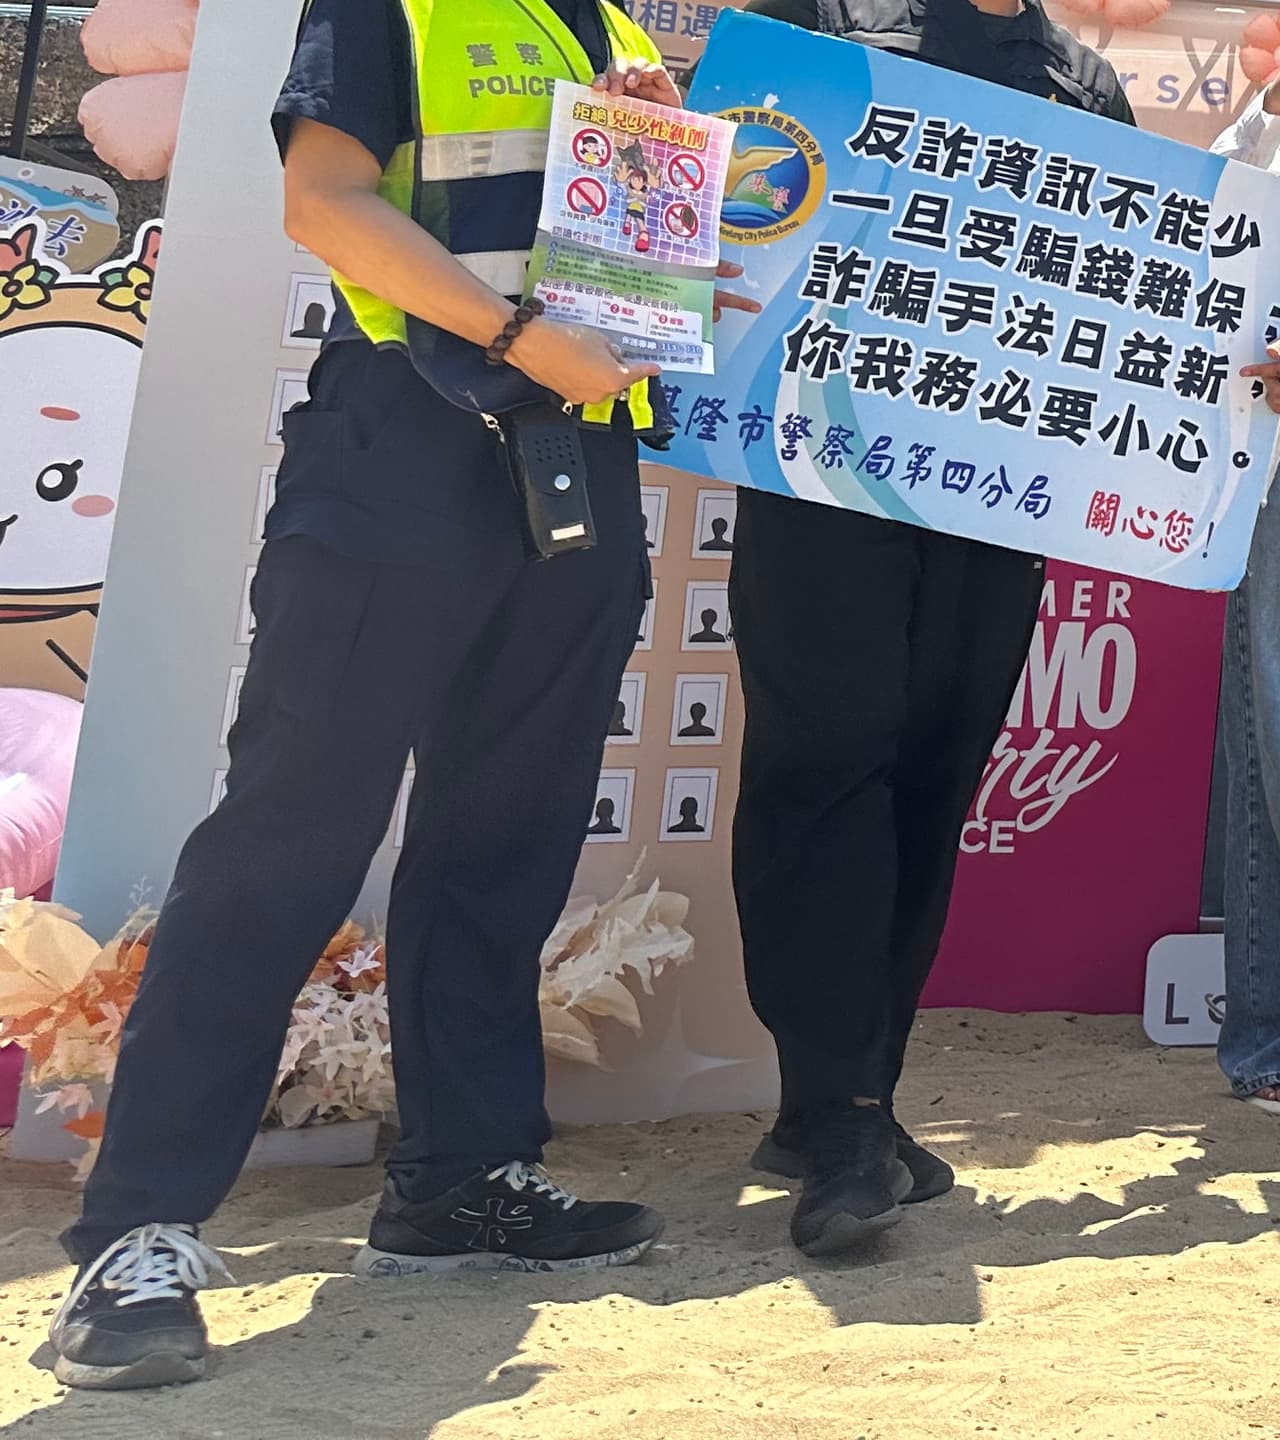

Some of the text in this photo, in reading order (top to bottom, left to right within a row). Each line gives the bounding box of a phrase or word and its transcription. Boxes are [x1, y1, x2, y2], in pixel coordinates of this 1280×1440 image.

[466, 43, 543, 67] 警察
[468, 75, 556, 98] POLICE
[573, 102, 609, 125] 拒絕
[722, 110, 825, 166] 市警察局第四分局
[804, 245, 1266, 405] 詐騙手法日益新，
[784, 319, 1251, 472] 你我務必要小心。
[1085, 491, 1215, 560] 關心您！
